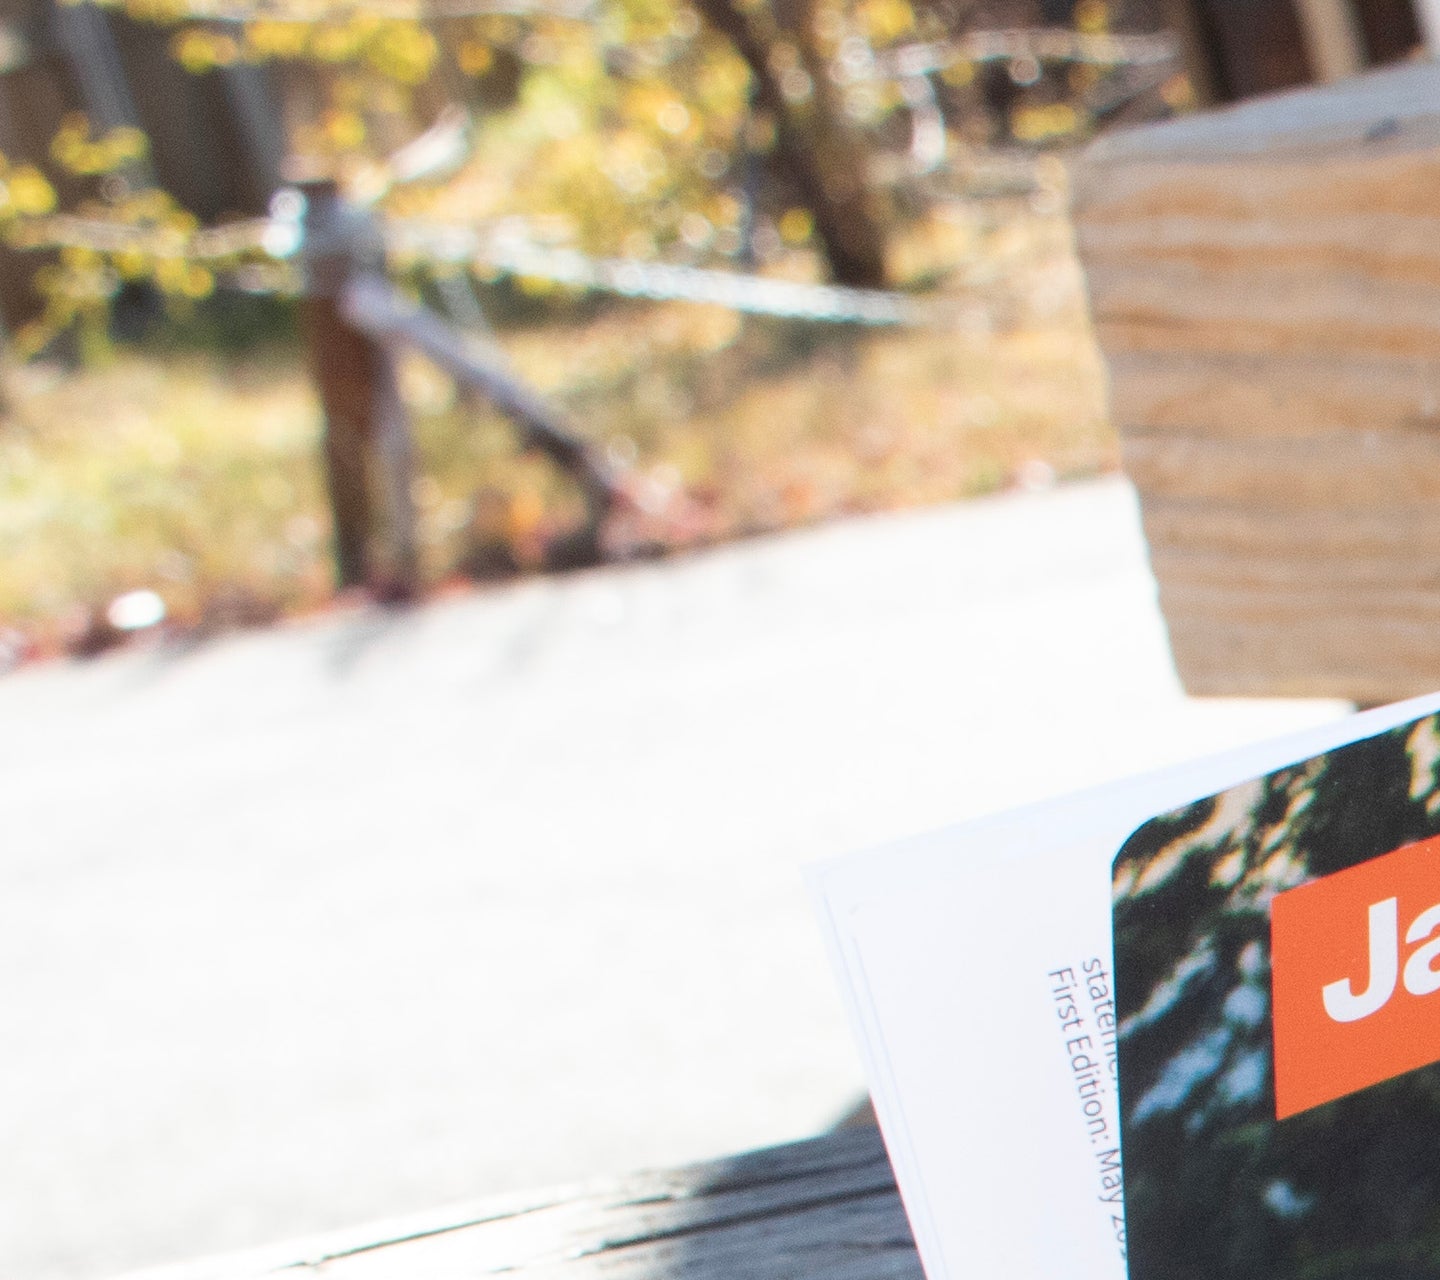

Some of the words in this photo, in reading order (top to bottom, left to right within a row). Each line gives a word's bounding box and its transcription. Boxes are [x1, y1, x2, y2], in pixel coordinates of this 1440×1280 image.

[1048, 967, 1084, 1032] First
[1066, 1034, 1110, 1145] Edition:
[1095, 1148, 1124, 1204] May
